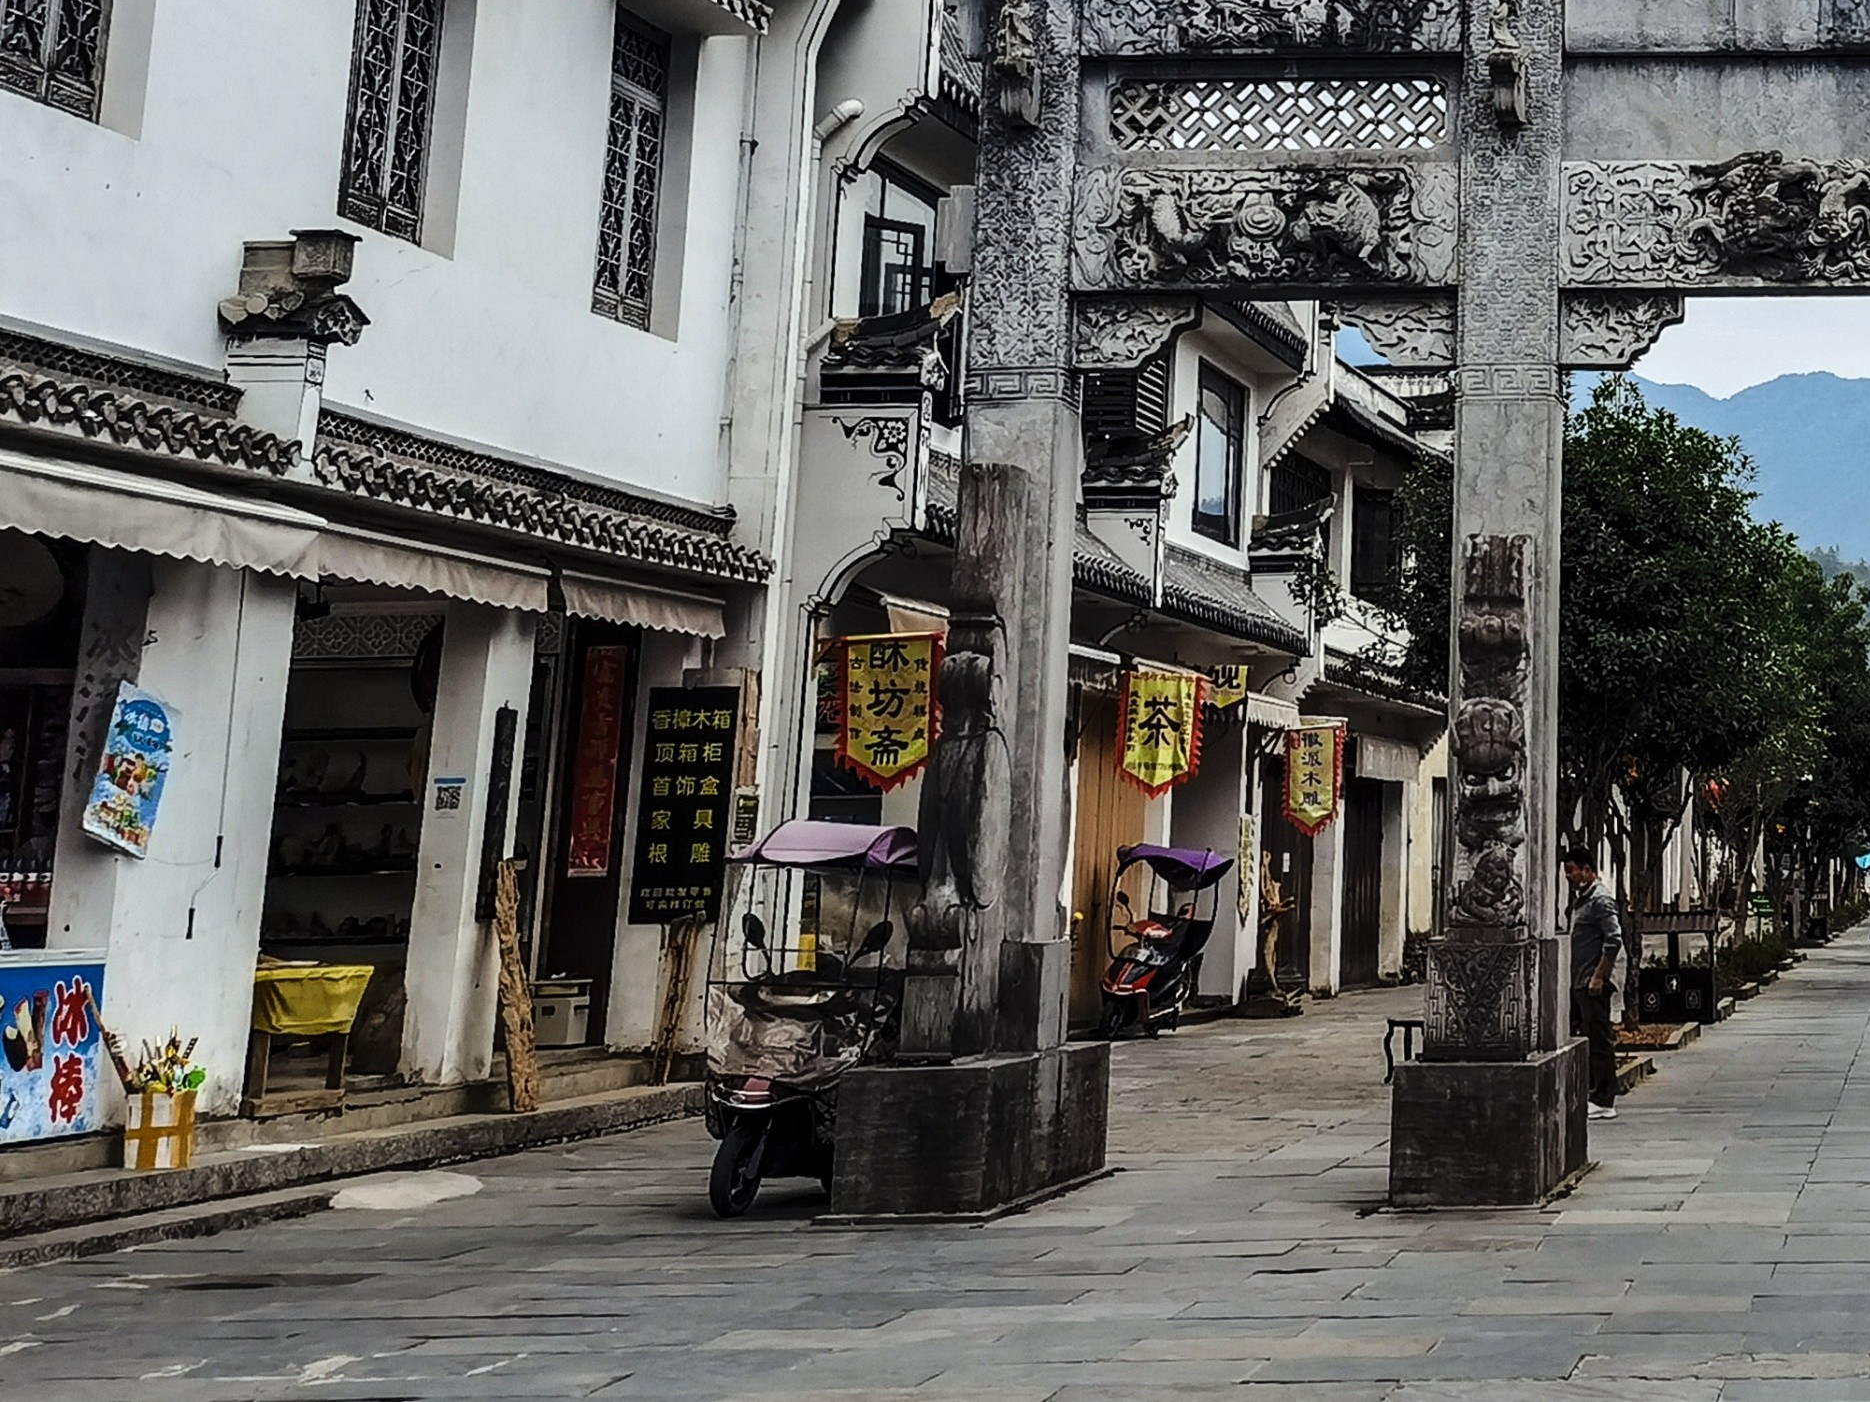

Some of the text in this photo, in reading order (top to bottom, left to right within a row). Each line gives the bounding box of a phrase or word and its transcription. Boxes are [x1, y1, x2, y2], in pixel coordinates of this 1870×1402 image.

[652, 709, 733, 731] 香樟木箱
[1138, 695, 1180, 749] 茶
[655, 742, 723, 763] 顶箱柜
[653, 775, 720, 797] 首饰盒
[648, 843, 710, 864] 根雕
